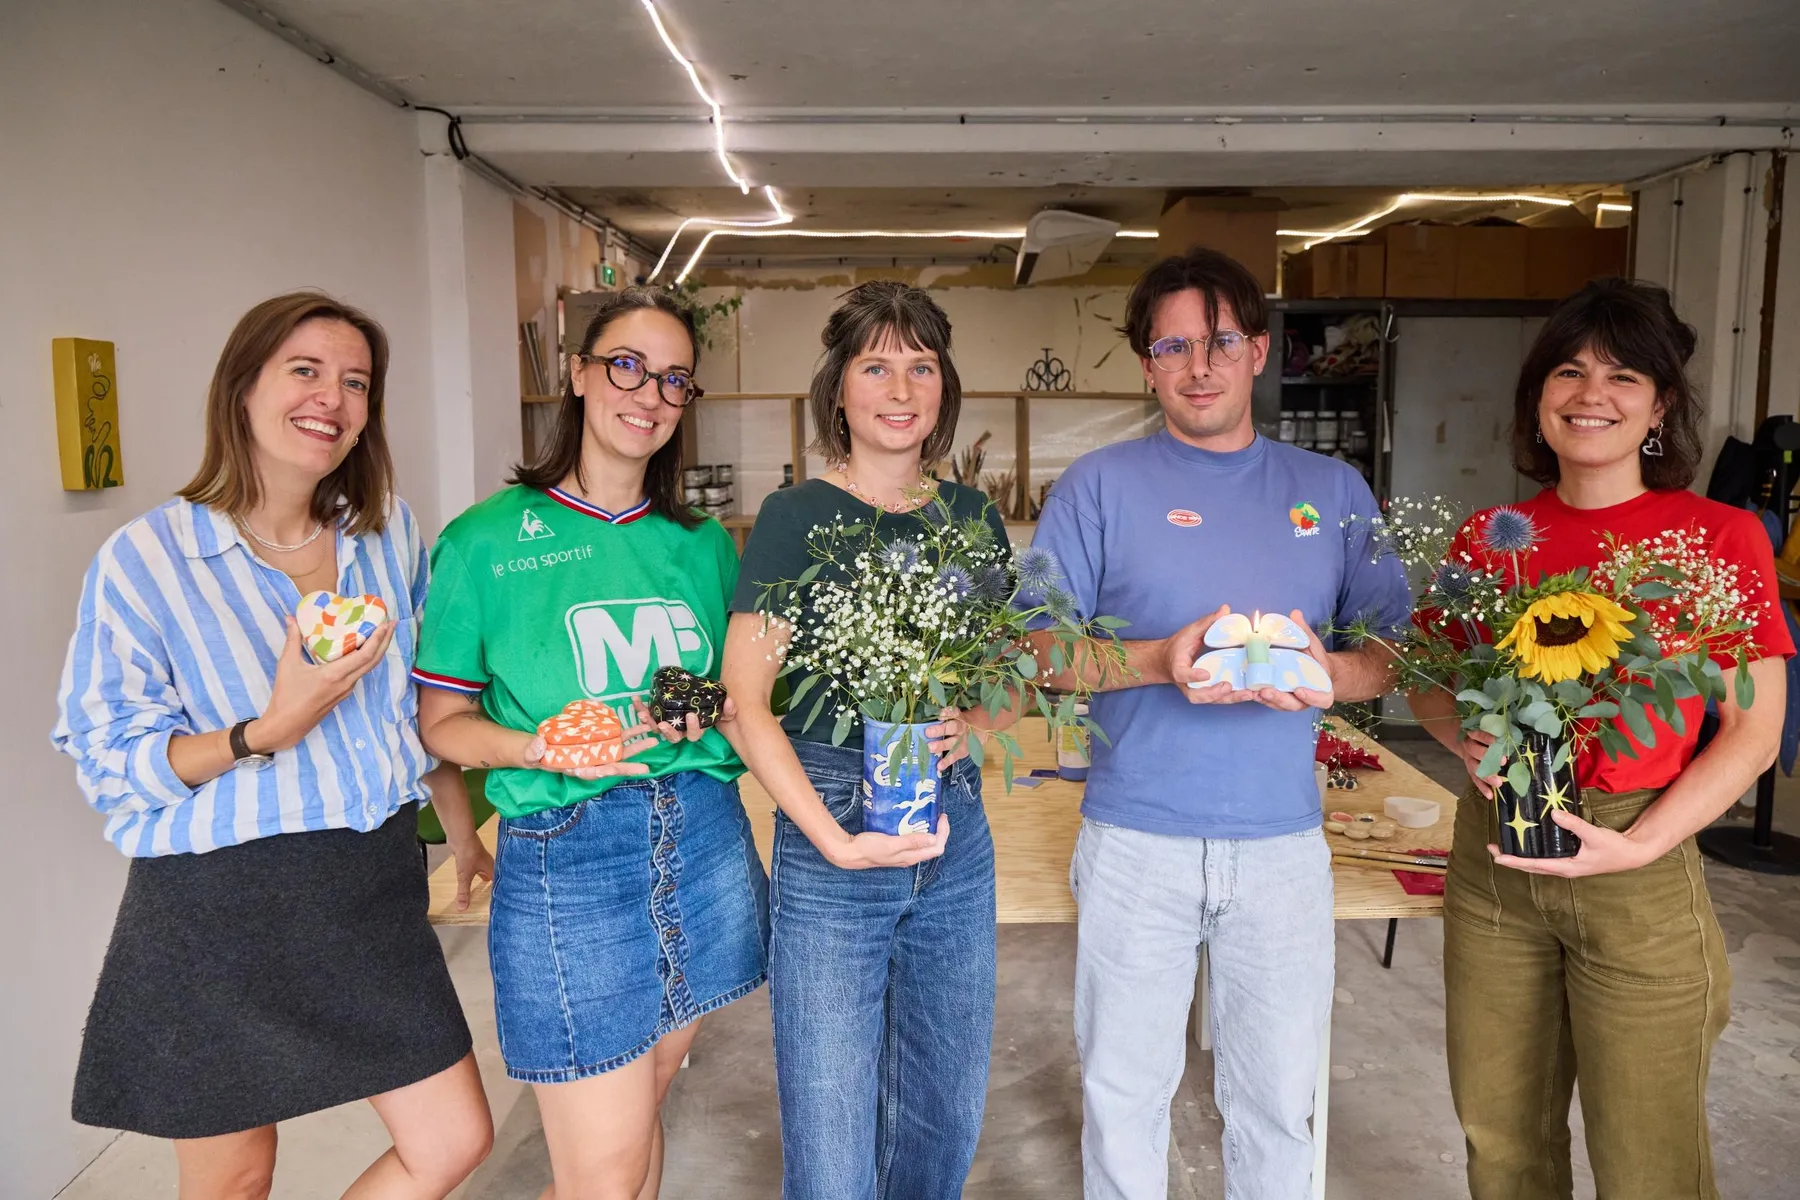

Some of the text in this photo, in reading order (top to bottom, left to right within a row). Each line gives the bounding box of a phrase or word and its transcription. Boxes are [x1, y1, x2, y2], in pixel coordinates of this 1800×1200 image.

[491, 544, 593, 578] le coq sportif
